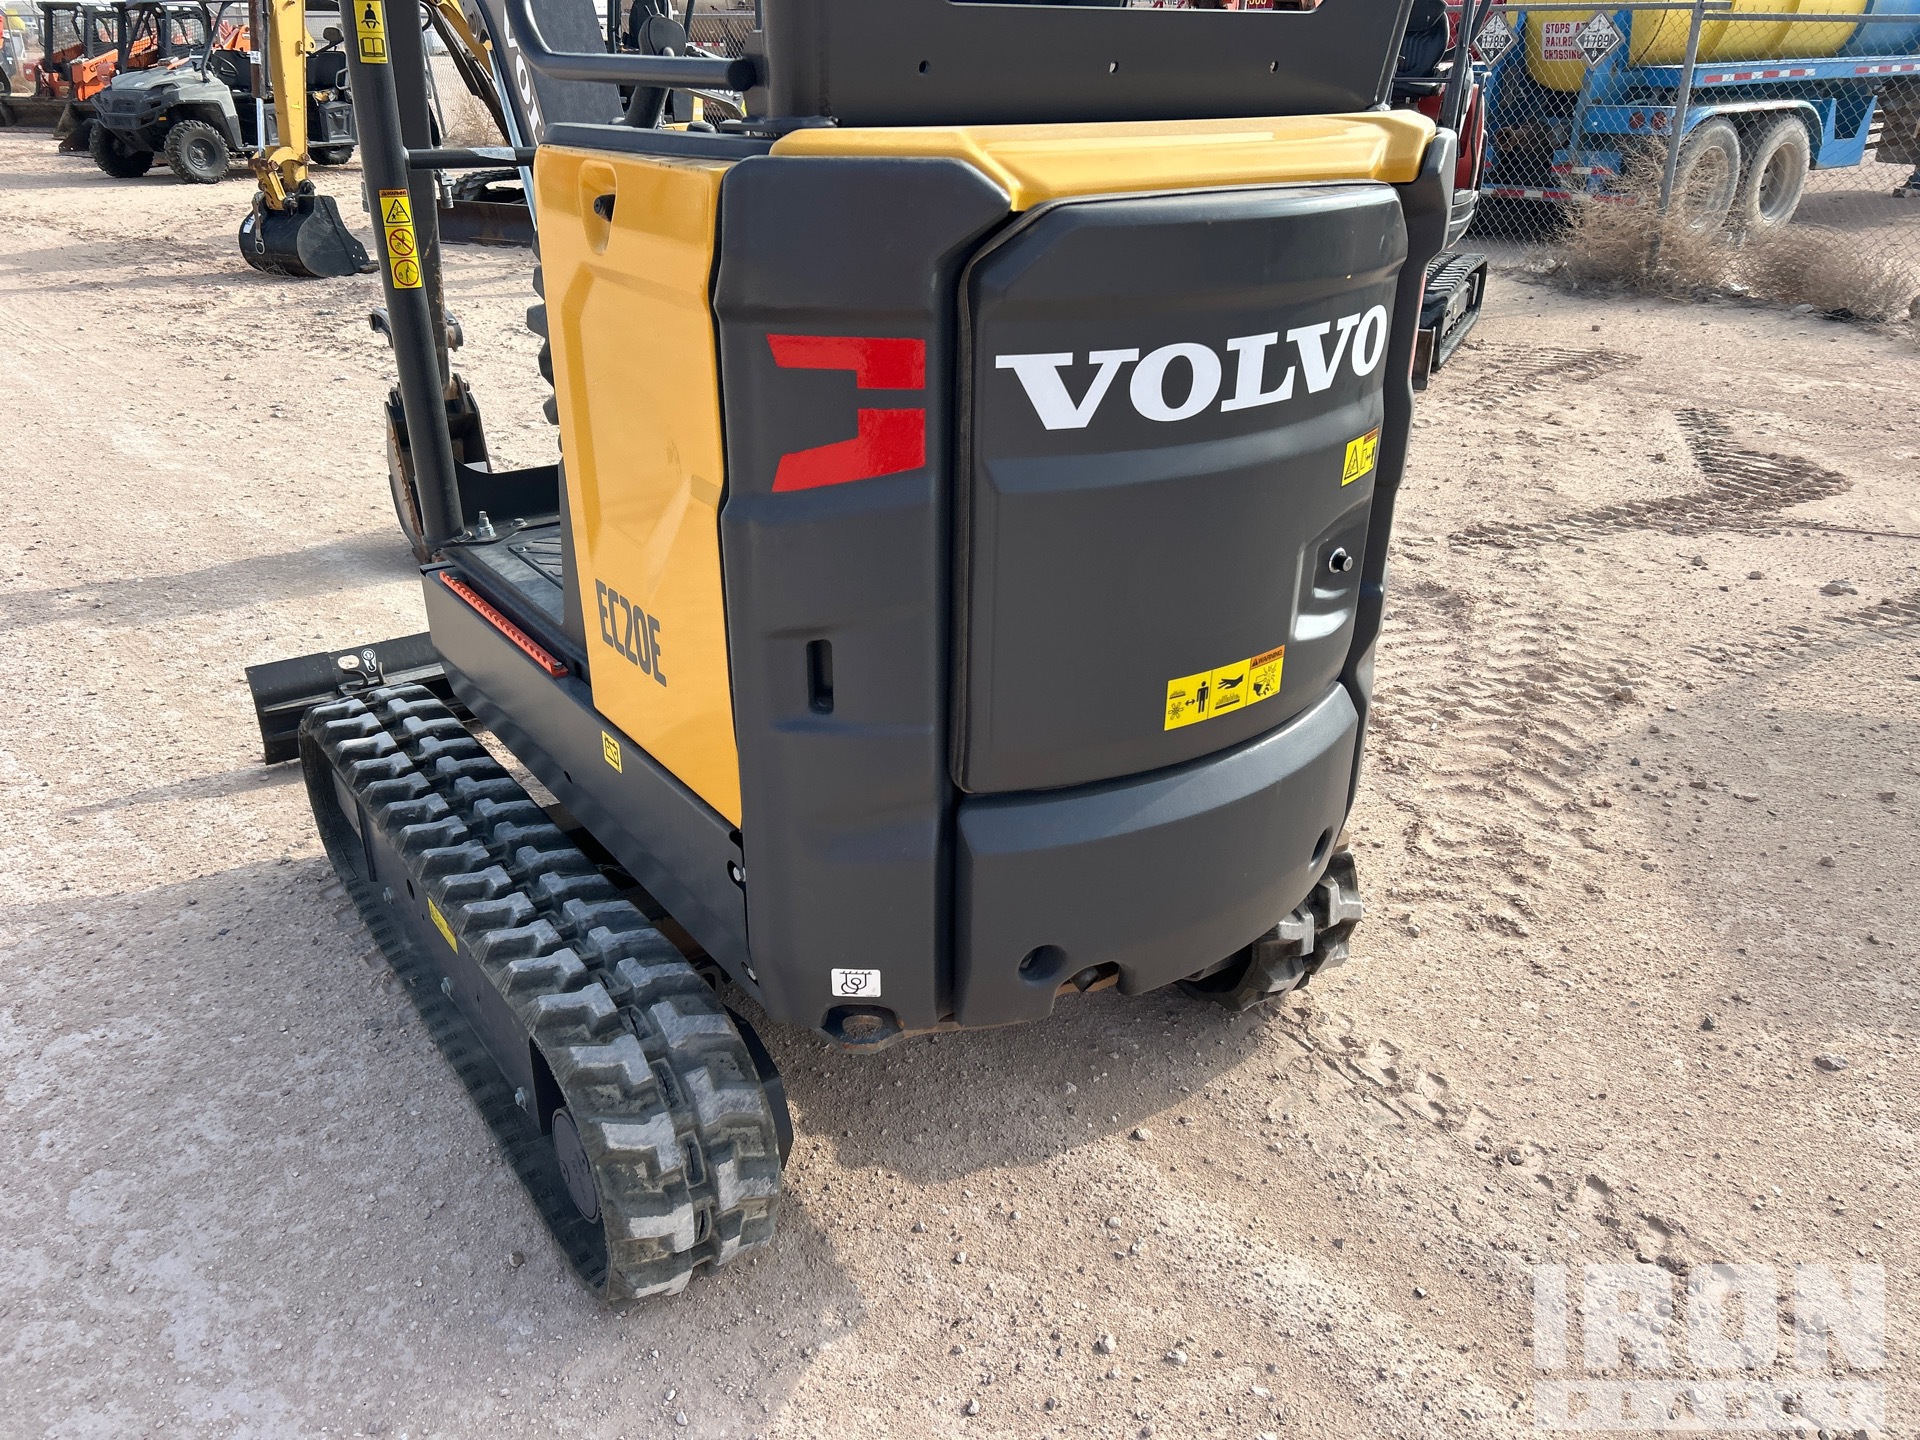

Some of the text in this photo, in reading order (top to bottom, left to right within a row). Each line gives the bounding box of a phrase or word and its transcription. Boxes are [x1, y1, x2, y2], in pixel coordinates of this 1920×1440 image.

[1545, 22, 1571, 34] STOPS
[1482, 34, 1505, 48] 1789
[1545, 36, 1573, 47] RAILRO
[1585, 34, 1610, 47] 1789
[995, 304, 1388, 430] VOLVO
[595, 578, 667, 687] EC20E
[1258, 649, 1283, 663] WARNING
